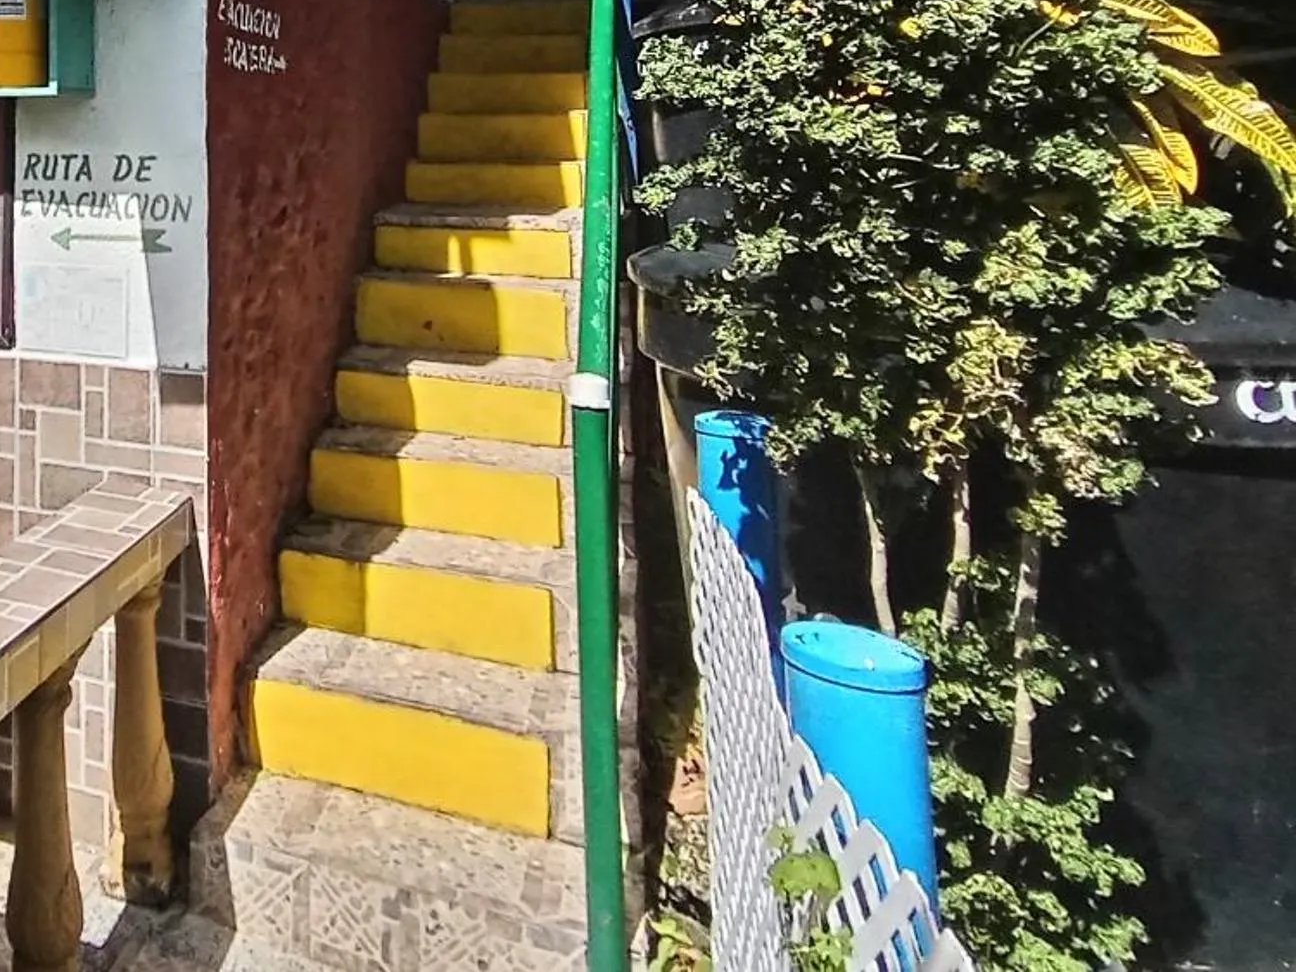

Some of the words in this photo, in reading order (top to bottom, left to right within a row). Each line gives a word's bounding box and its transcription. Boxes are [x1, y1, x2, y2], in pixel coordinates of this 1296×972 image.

[22, 153, 93, 182] RUTA
[113, 154, 158, 182] DE
[20, 189, 193, 222] EVACUACION
